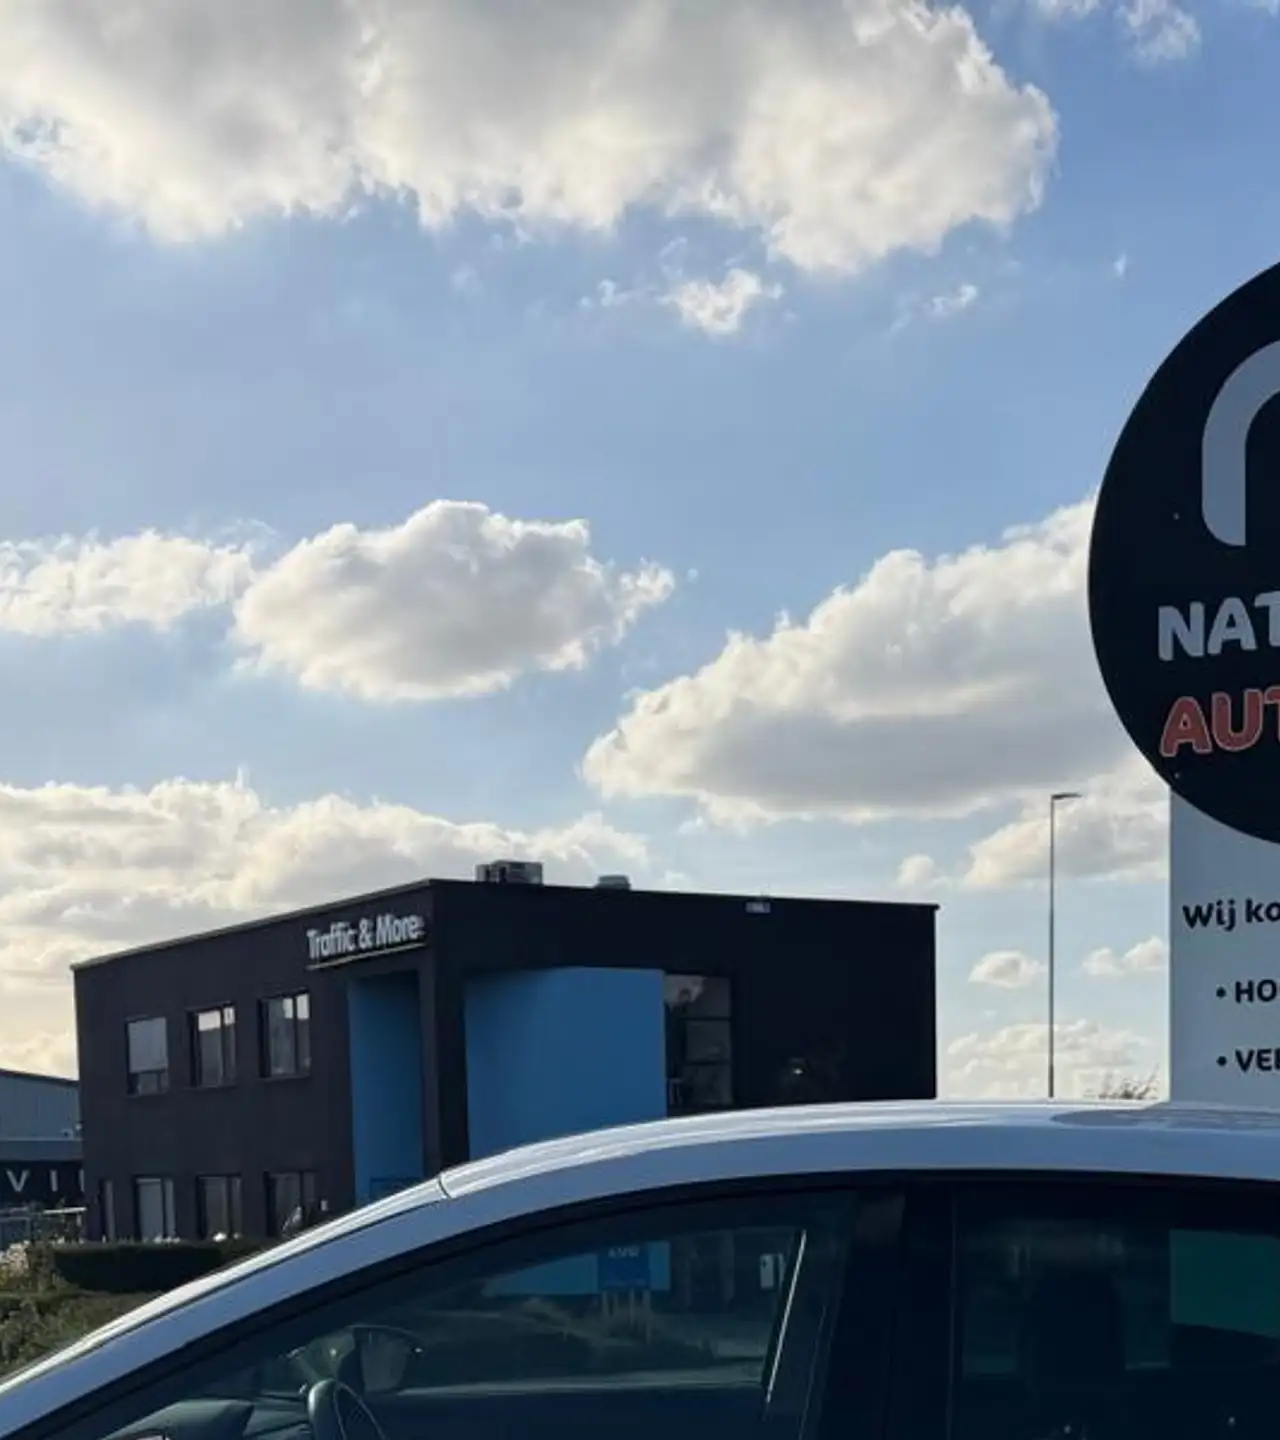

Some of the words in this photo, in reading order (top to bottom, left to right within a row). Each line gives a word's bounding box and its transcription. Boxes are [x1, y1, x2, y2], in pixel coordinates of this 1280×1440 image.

[1182, 899, 1237, 931] Wij
[306, 921, 357, 959] Traffic
[358, 917, 373, 949] &
[376, 912, 424, 946] More
